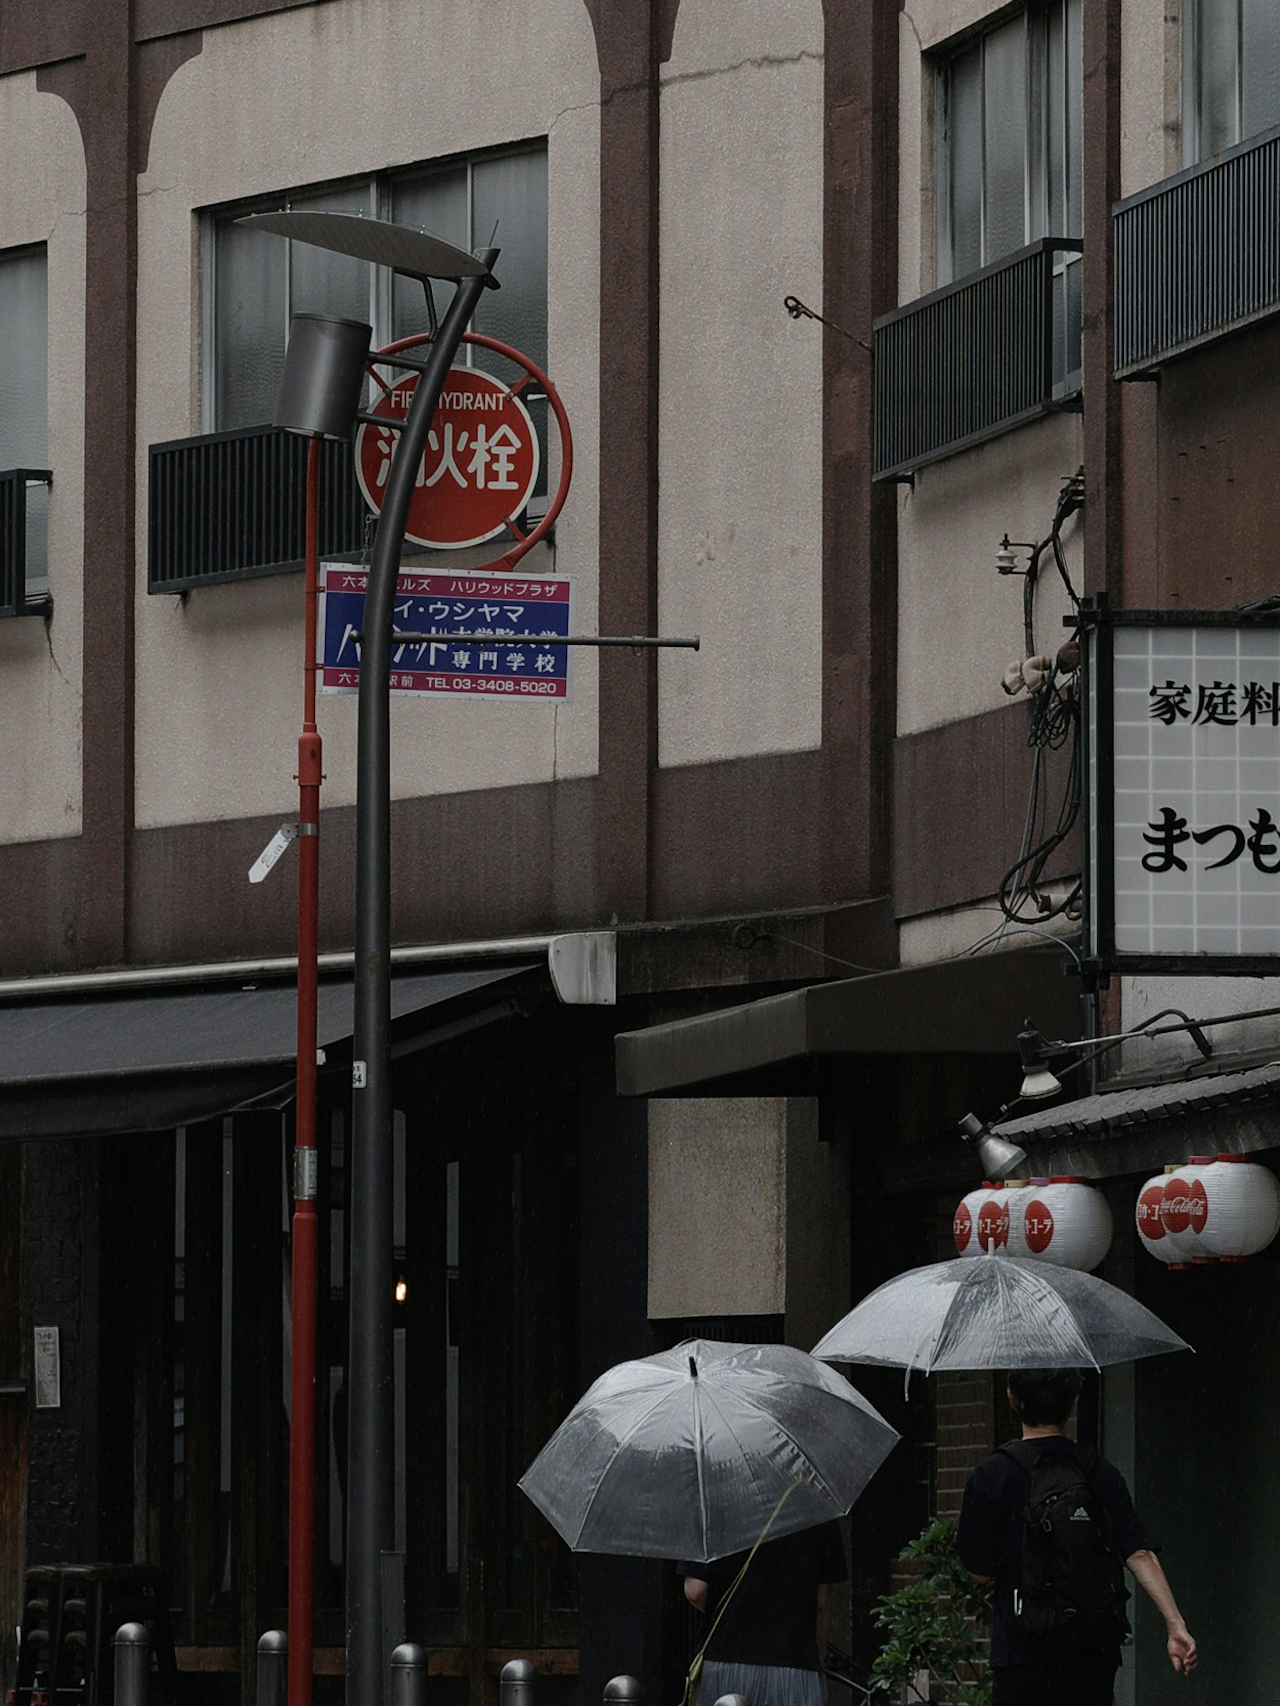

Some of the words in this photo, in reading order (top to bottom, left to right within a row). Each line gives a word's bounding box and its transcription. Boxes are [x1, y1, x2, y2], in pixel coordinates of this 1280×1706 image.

[390, 390, 415, 409] FIR
[342, 575, 432, 591] 六本ルズ
[393, 598, 526, 624] イ・ウシヤマ
[451, 649, 556, 673] 専門学校
[425, 676, 451, 689] TEL
[452, 678, 557, 694] 03-3408-5020
